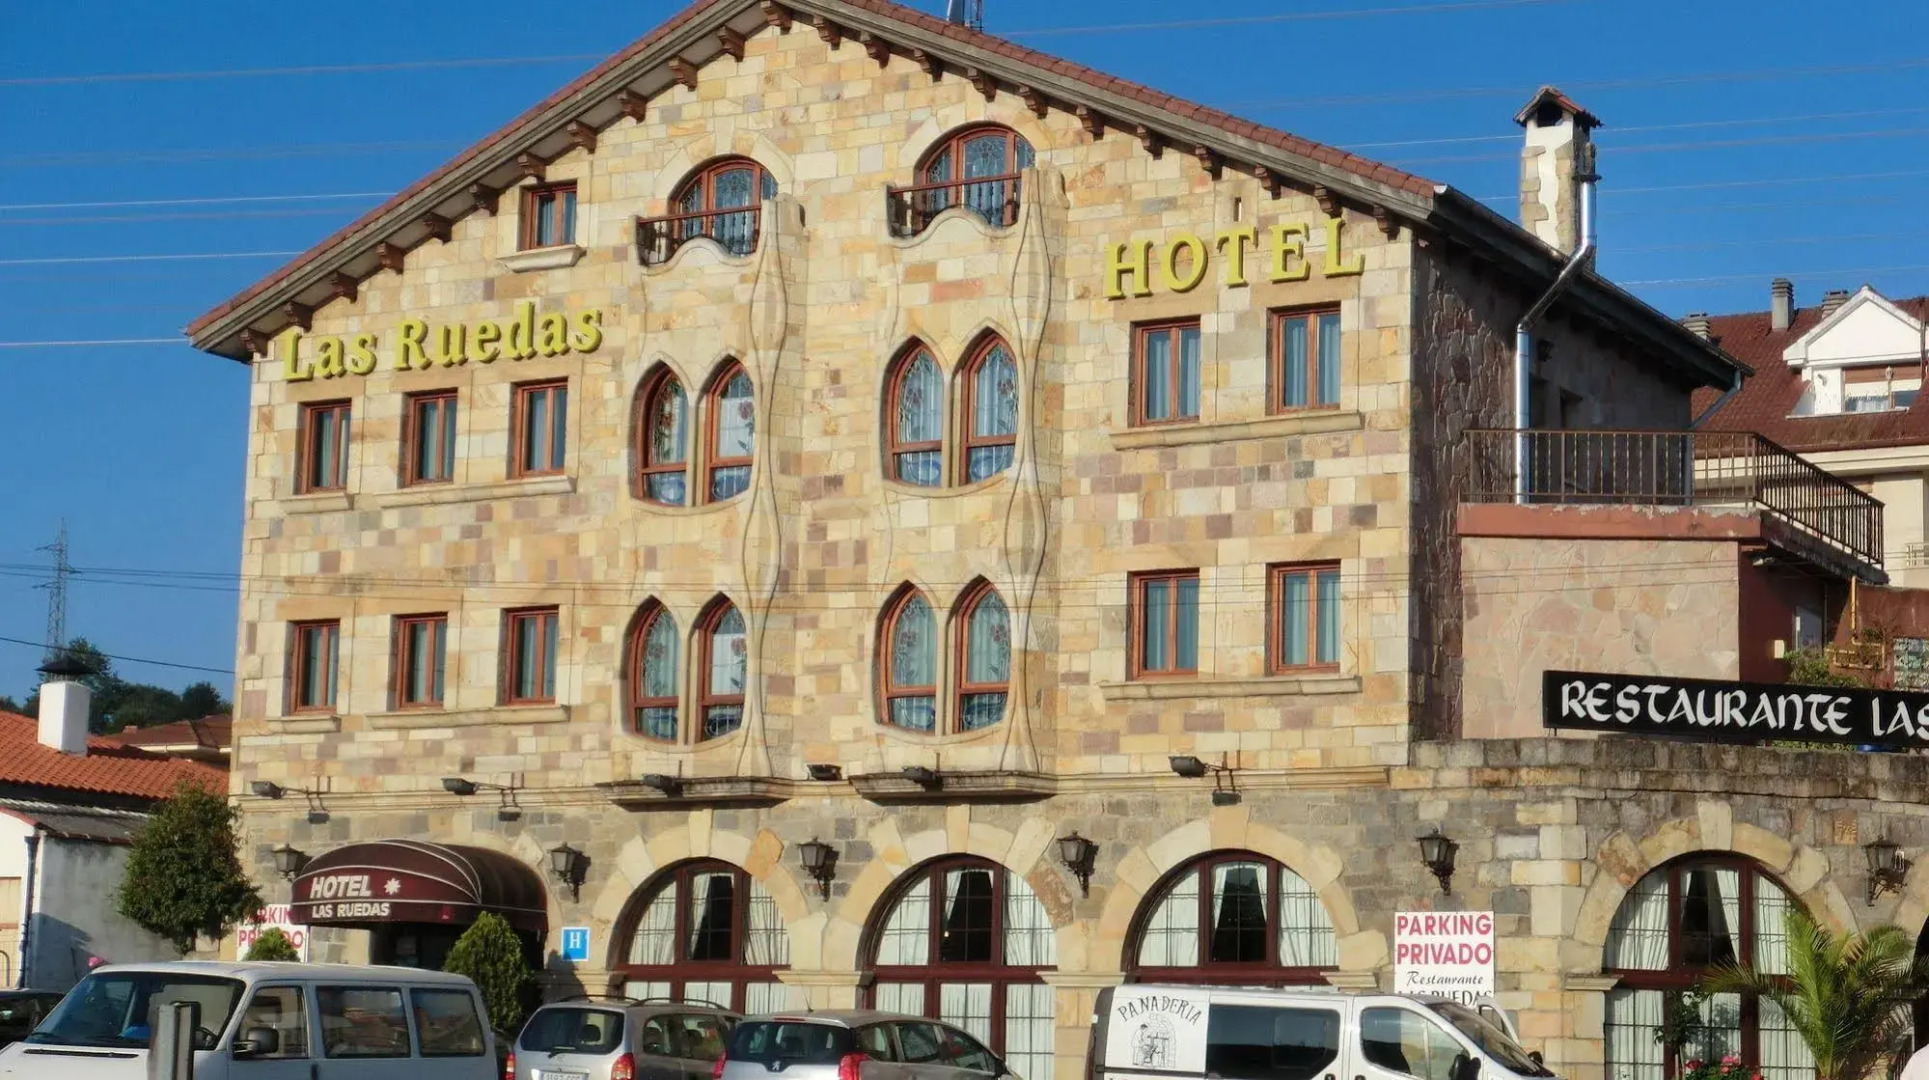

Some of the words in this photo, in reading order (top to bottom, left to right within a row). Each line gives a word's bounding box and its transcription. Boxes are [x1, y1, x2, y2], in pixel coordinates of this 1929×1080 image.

[1104, 217, 1365, 301] HOTEL
[282, 330, 378, 382] Las
[393, 300, 603, 371] Ruedas
[1561, 679, 1853, 735] RESTAURANTE
[309, 874, 372, 899] HOTEL
[311, 903, 333, 918] LAS
[336, 902, 390, 917] RUEDAS
[1397, 914, 1492, 936] PARKING
[569, 931, 582, 949] H
[1397, 943, 1492, 965] PRIVADO
[1406, 970, 1484, 987] Restaurante
[1117, 995, 1203, 1025] PANADERIA
